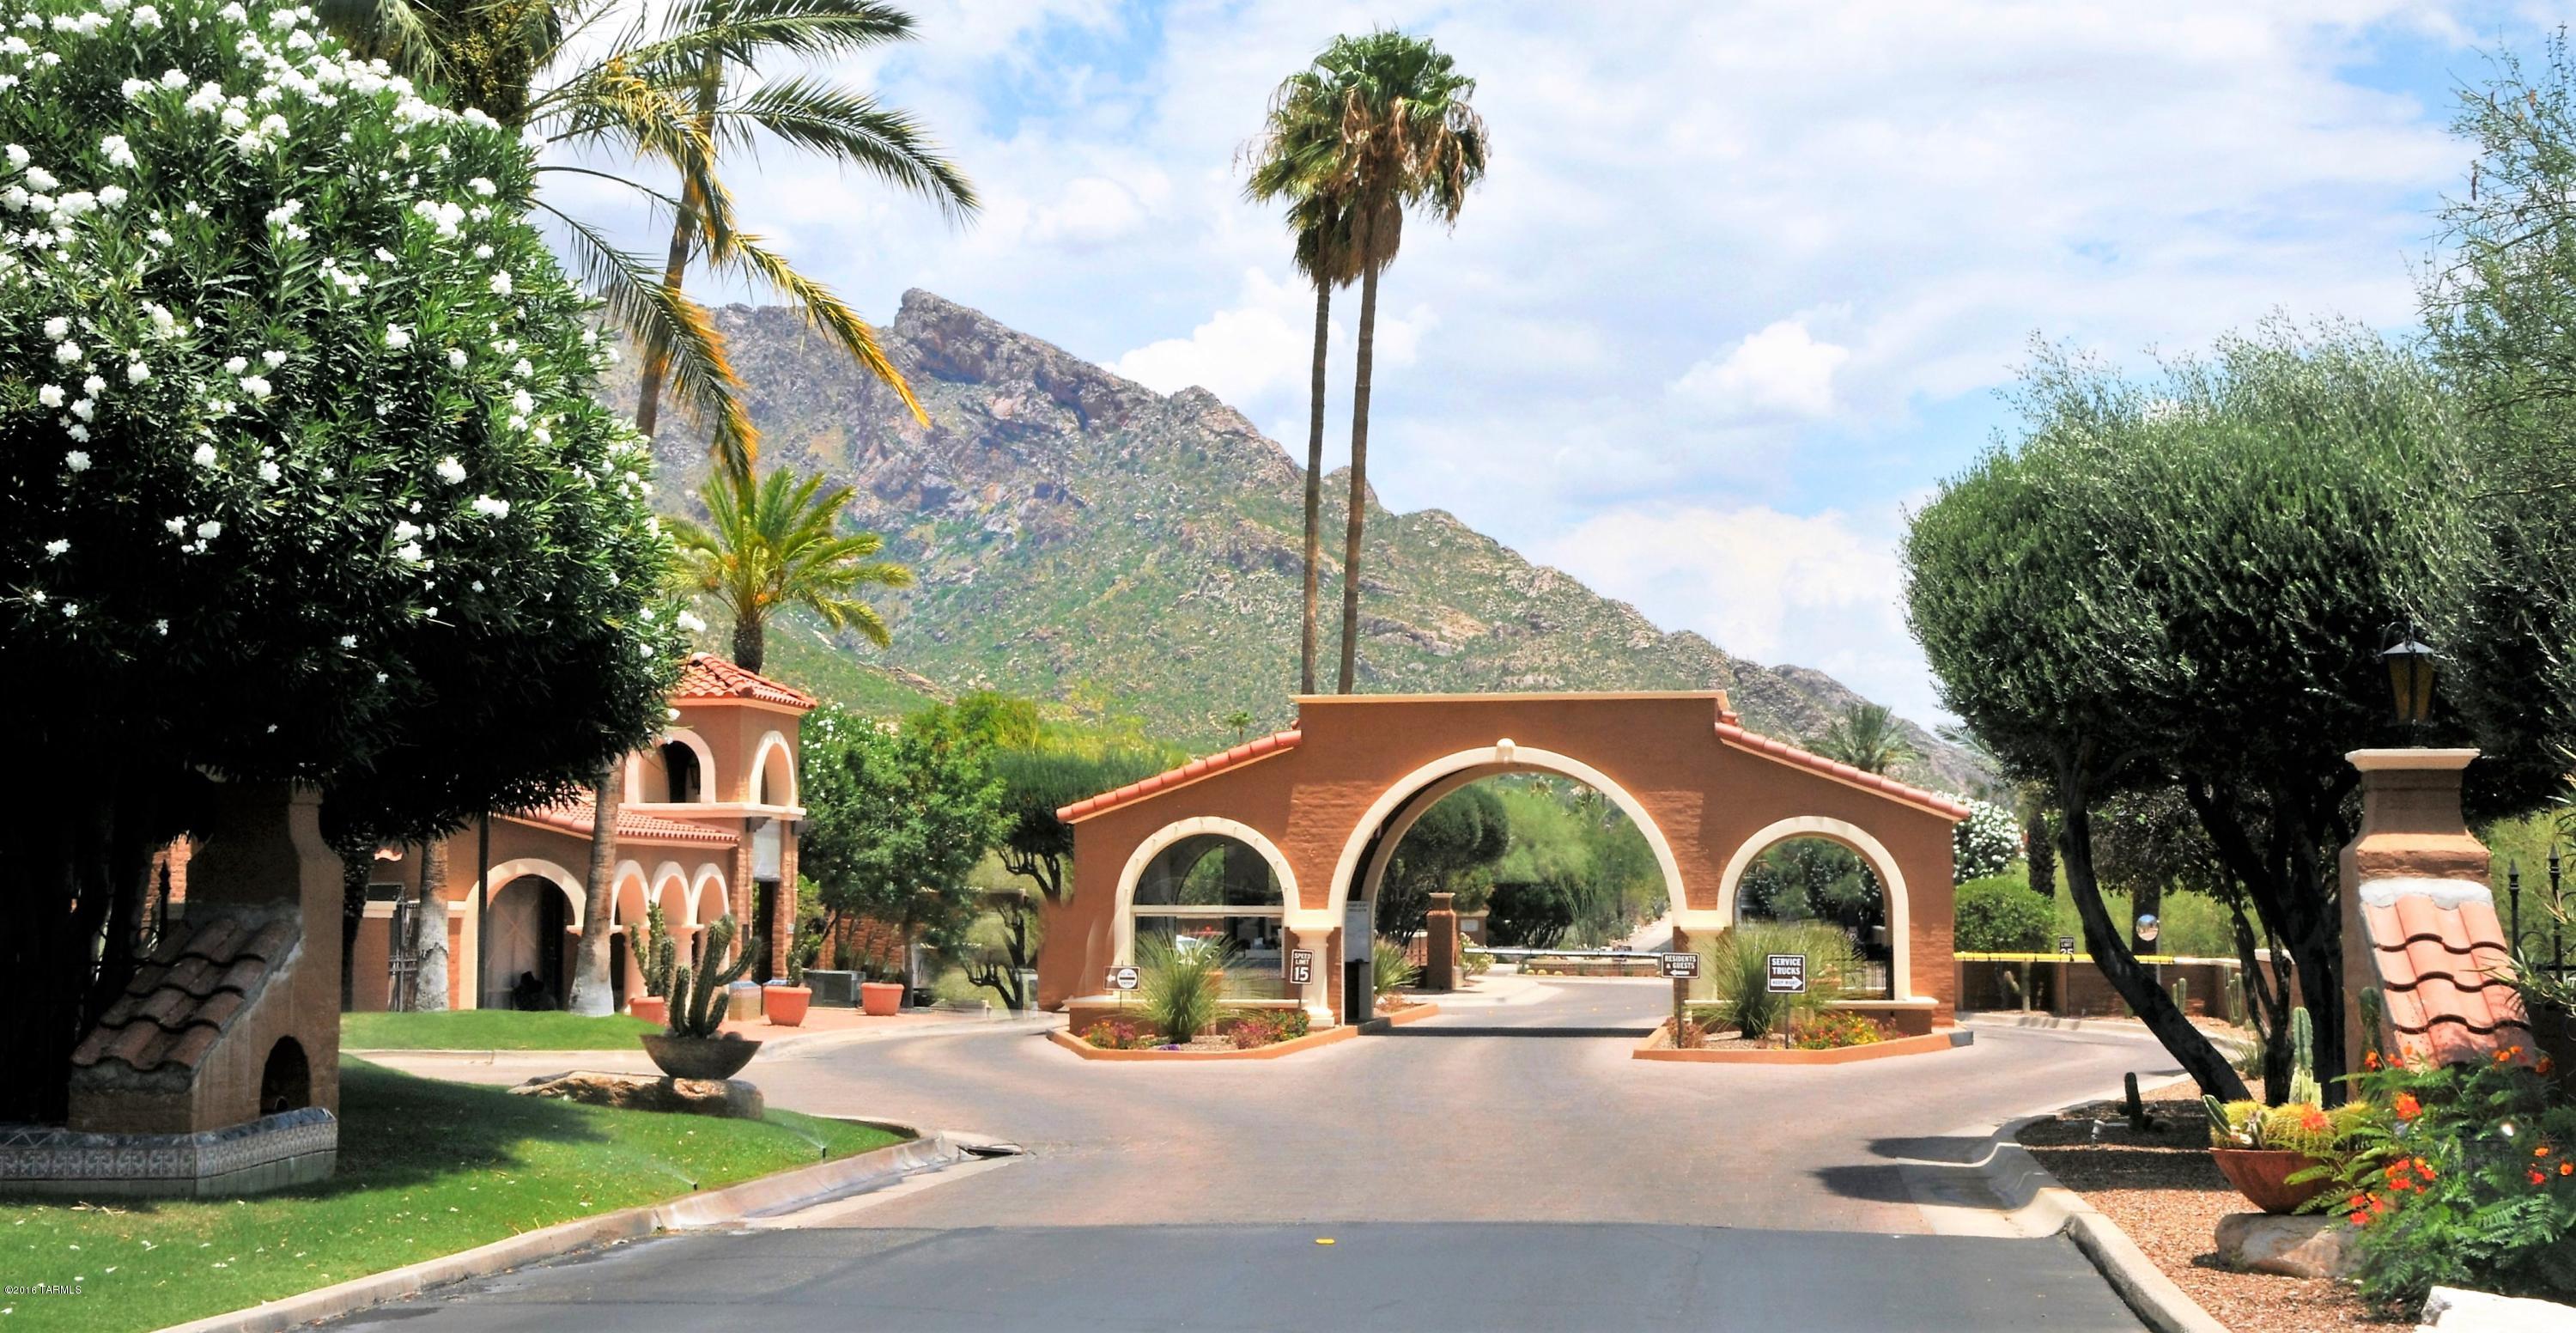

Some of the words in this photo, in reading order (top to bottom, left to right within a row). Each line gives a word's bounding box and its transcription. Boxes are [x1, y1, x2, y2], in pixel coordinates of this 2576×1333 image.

[1771, 958, 1801, 966] SERVICE
[1294, 966, 1309, 981] 15
[1771, 966, 1801, 975] TRUCKS
